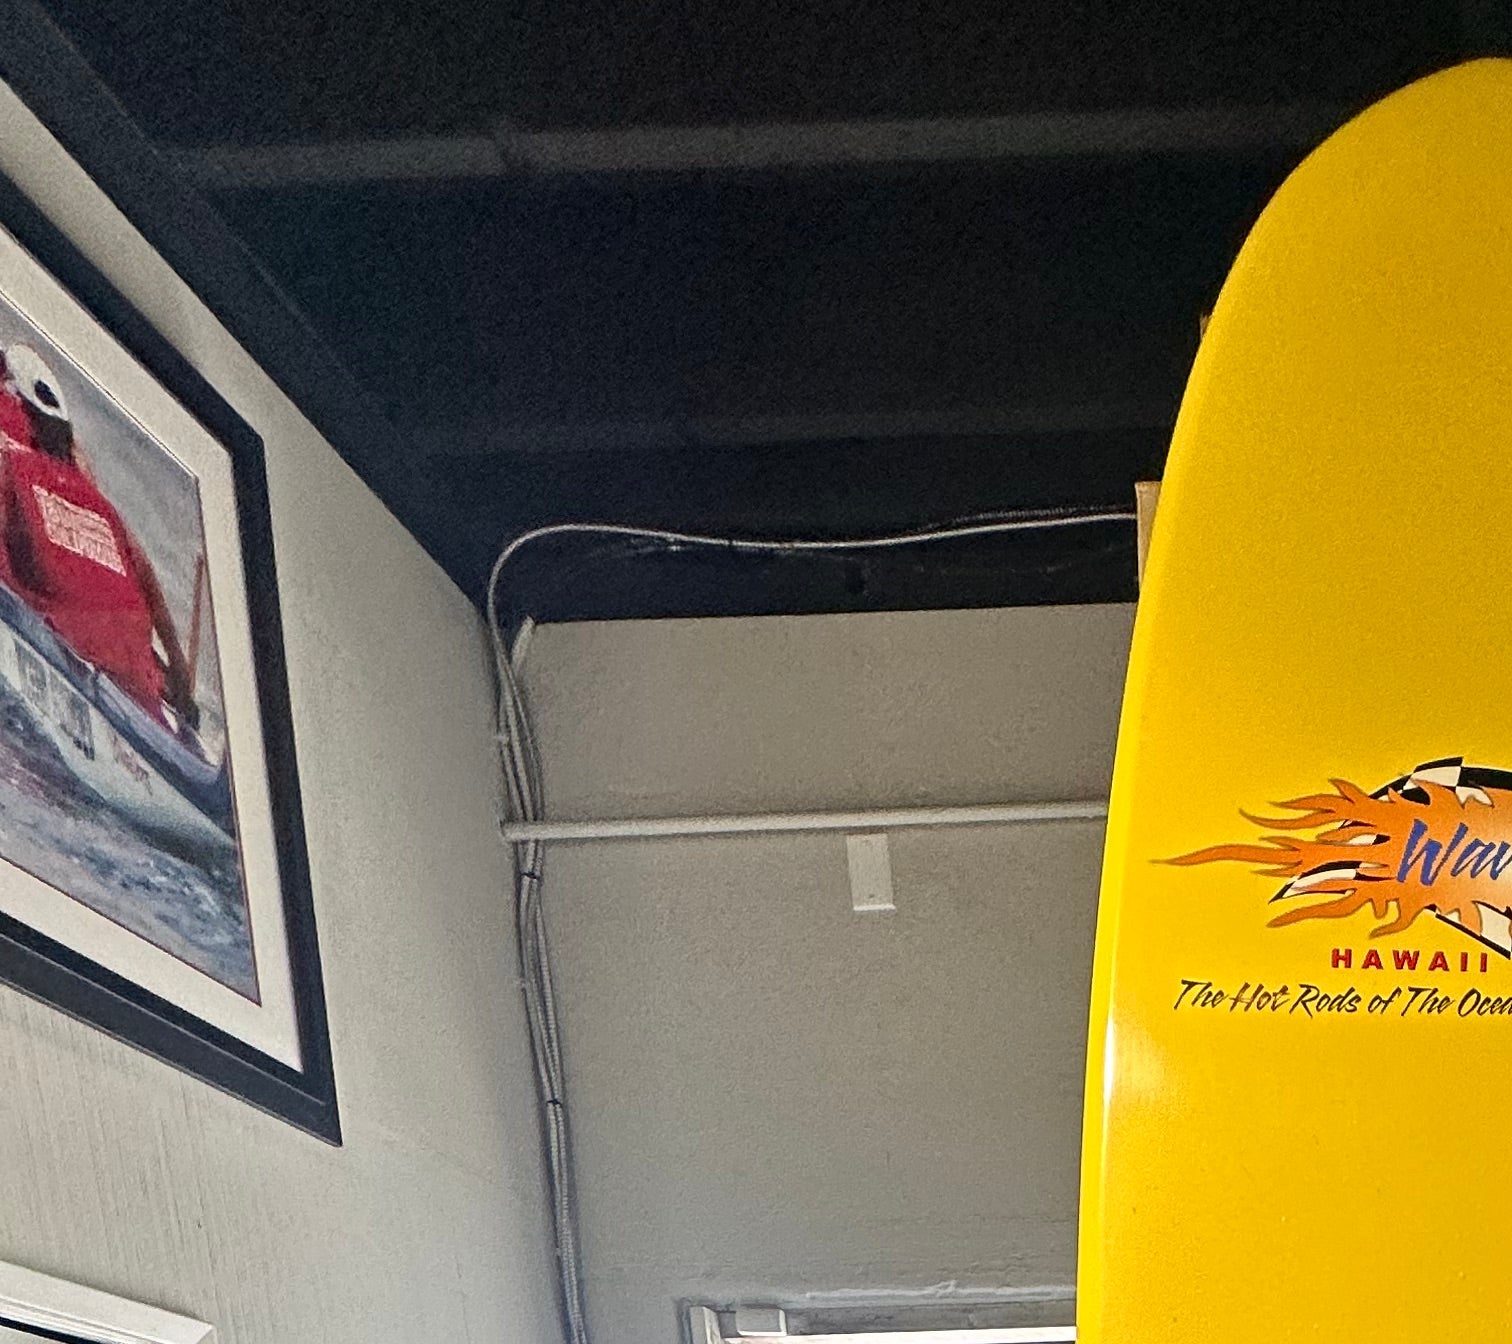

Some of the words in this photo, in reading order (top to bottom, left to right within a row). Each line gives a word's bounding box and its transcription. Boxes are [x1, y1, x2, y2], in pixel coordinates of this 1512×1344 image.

[1331, 948, 1488, 973] HAWAII
[1174, 979, 1229, 1010] The
[1229, 982, 1291, 1013] Hot
[1289, 983, 1361, 1018] Rods
[1367, 986, 1402, 1016] of
[1401, 985, 1454, 1017] The
